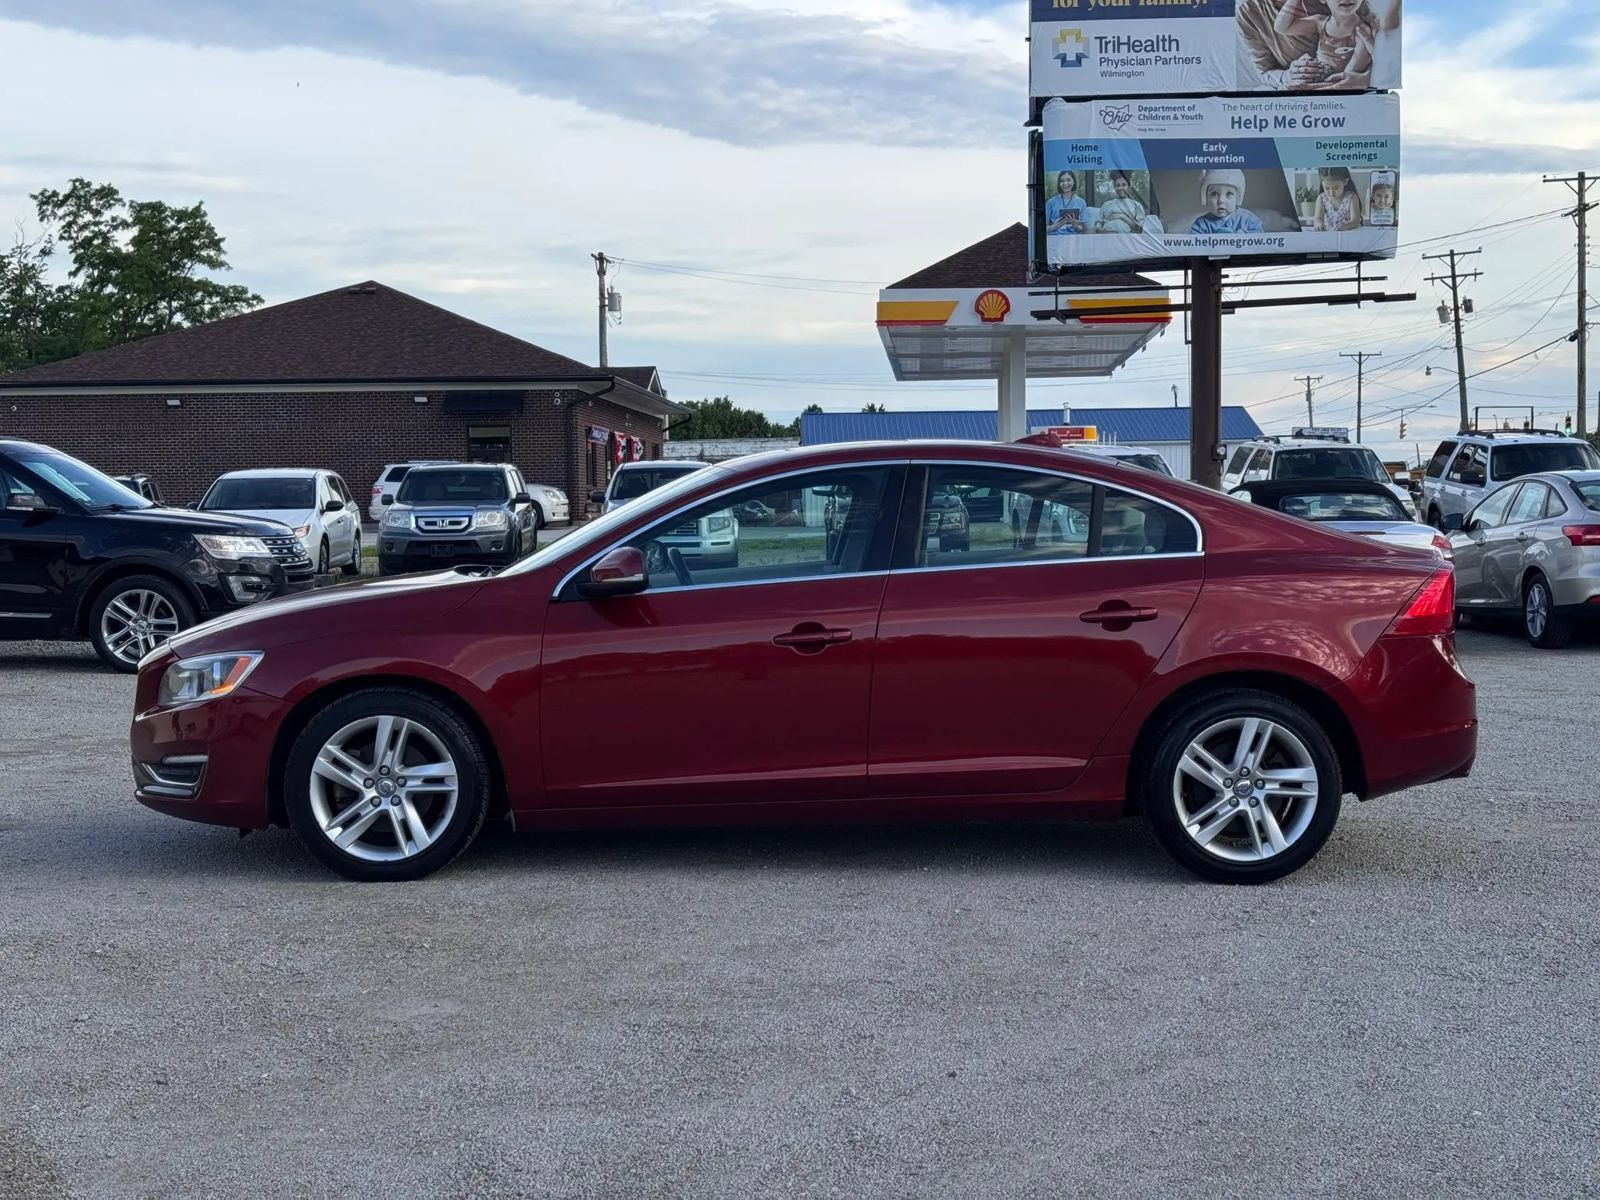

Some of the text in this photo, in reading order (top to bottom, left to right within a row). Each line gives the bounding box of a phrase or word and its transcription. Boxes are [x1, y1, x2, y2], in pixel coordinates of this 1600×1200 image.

[1094, 34, 1180, 54] TriHealth
[1099, 55, 1202, 69] Physician Partners
[1100, 70, 1145, 79] Wilmington
[1138, 104, 1196, 113] Department of
[1222, 101, 1346, 113] The heart of thriving families.
[1138, 113, 1204, 121] Children & Youth
[1230, 115, 1346, 133] Help Me Grow
[1071, 144, 1099, 152] Home
[1202, 142, 1228, 153] Early
[1315, 139, 1388, 151] Developmental
[1067, 154, 1103, 165] Visiting
[1185, 153, 1245, 163] Intervention
[1325, 151, 1378, 162] Screenings
[1163, 236, 1285, 248] www.helpmegrow.org
